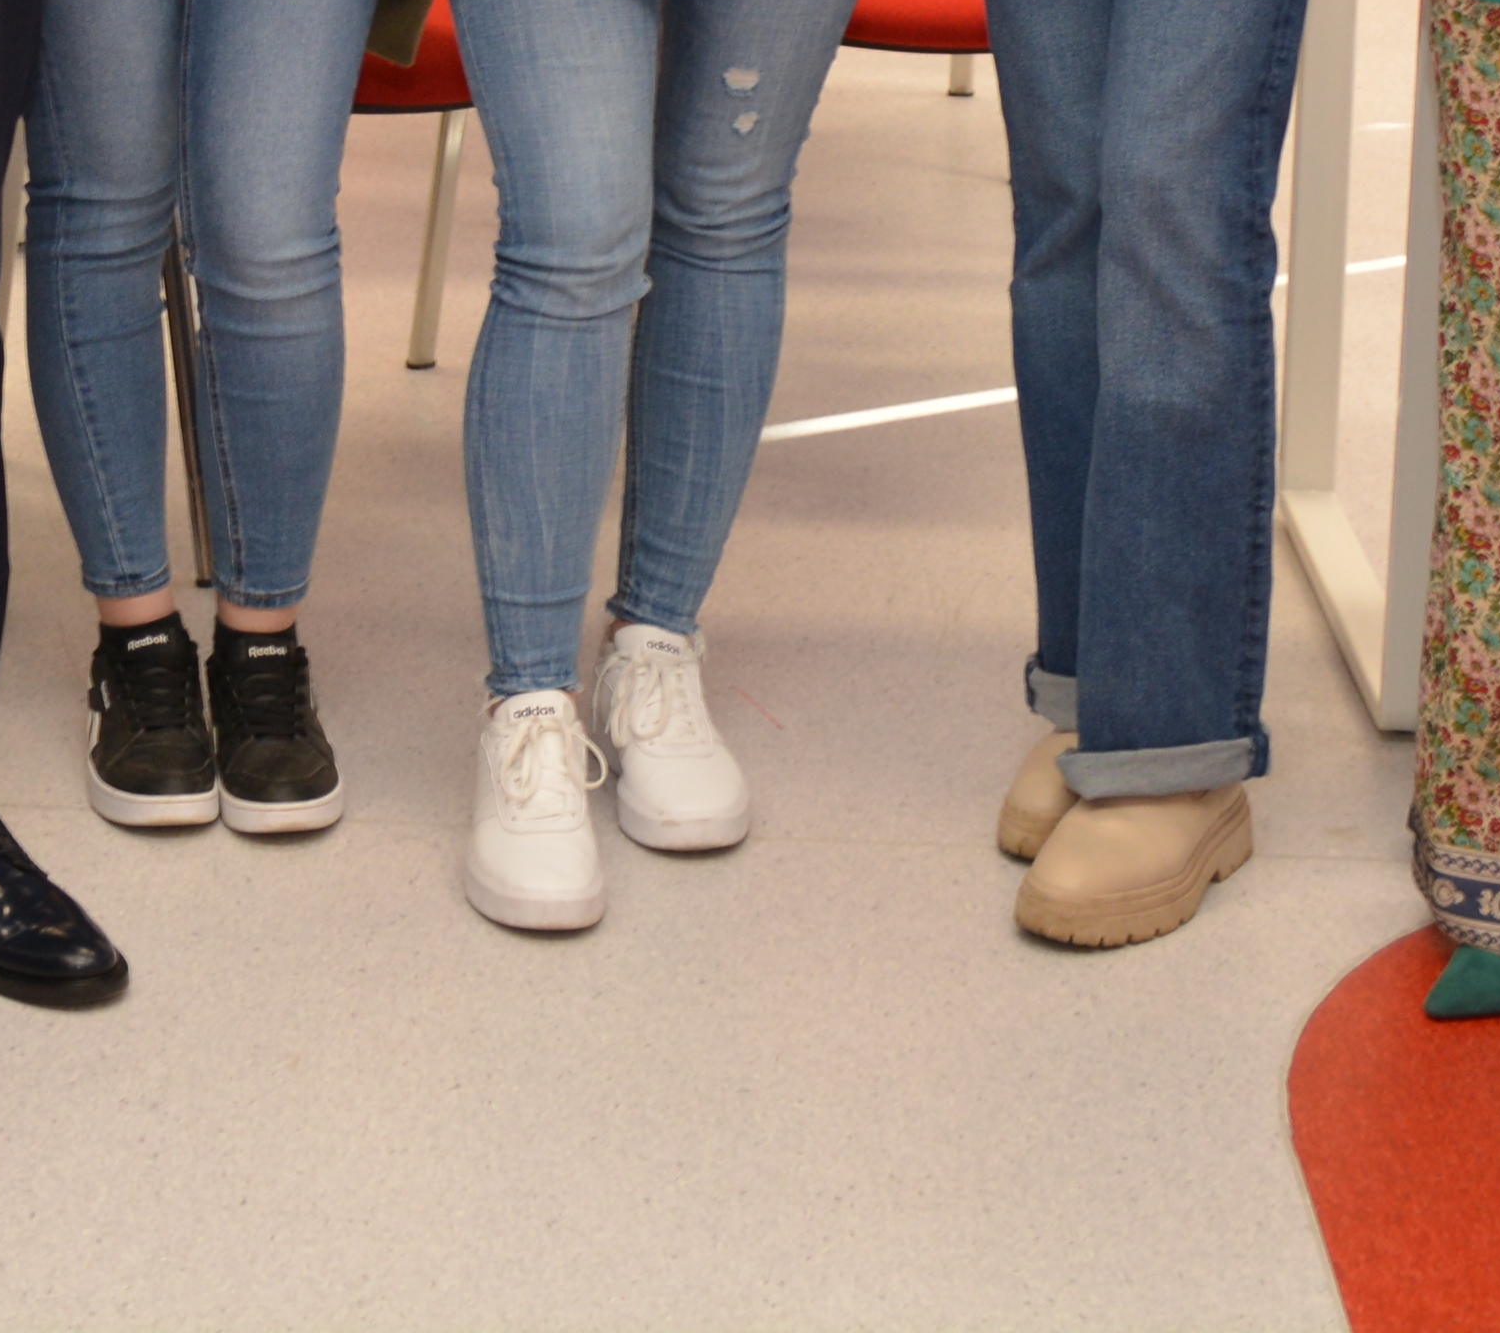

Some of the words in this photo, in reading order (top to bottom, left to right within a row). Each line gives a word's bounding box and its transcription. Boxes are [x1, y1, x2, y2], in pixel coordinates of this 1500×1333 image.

[127, 633, 169, 651] Reebok
[646, 641, 681, 656] adidas
[514, 705, 556, 719] adidas
